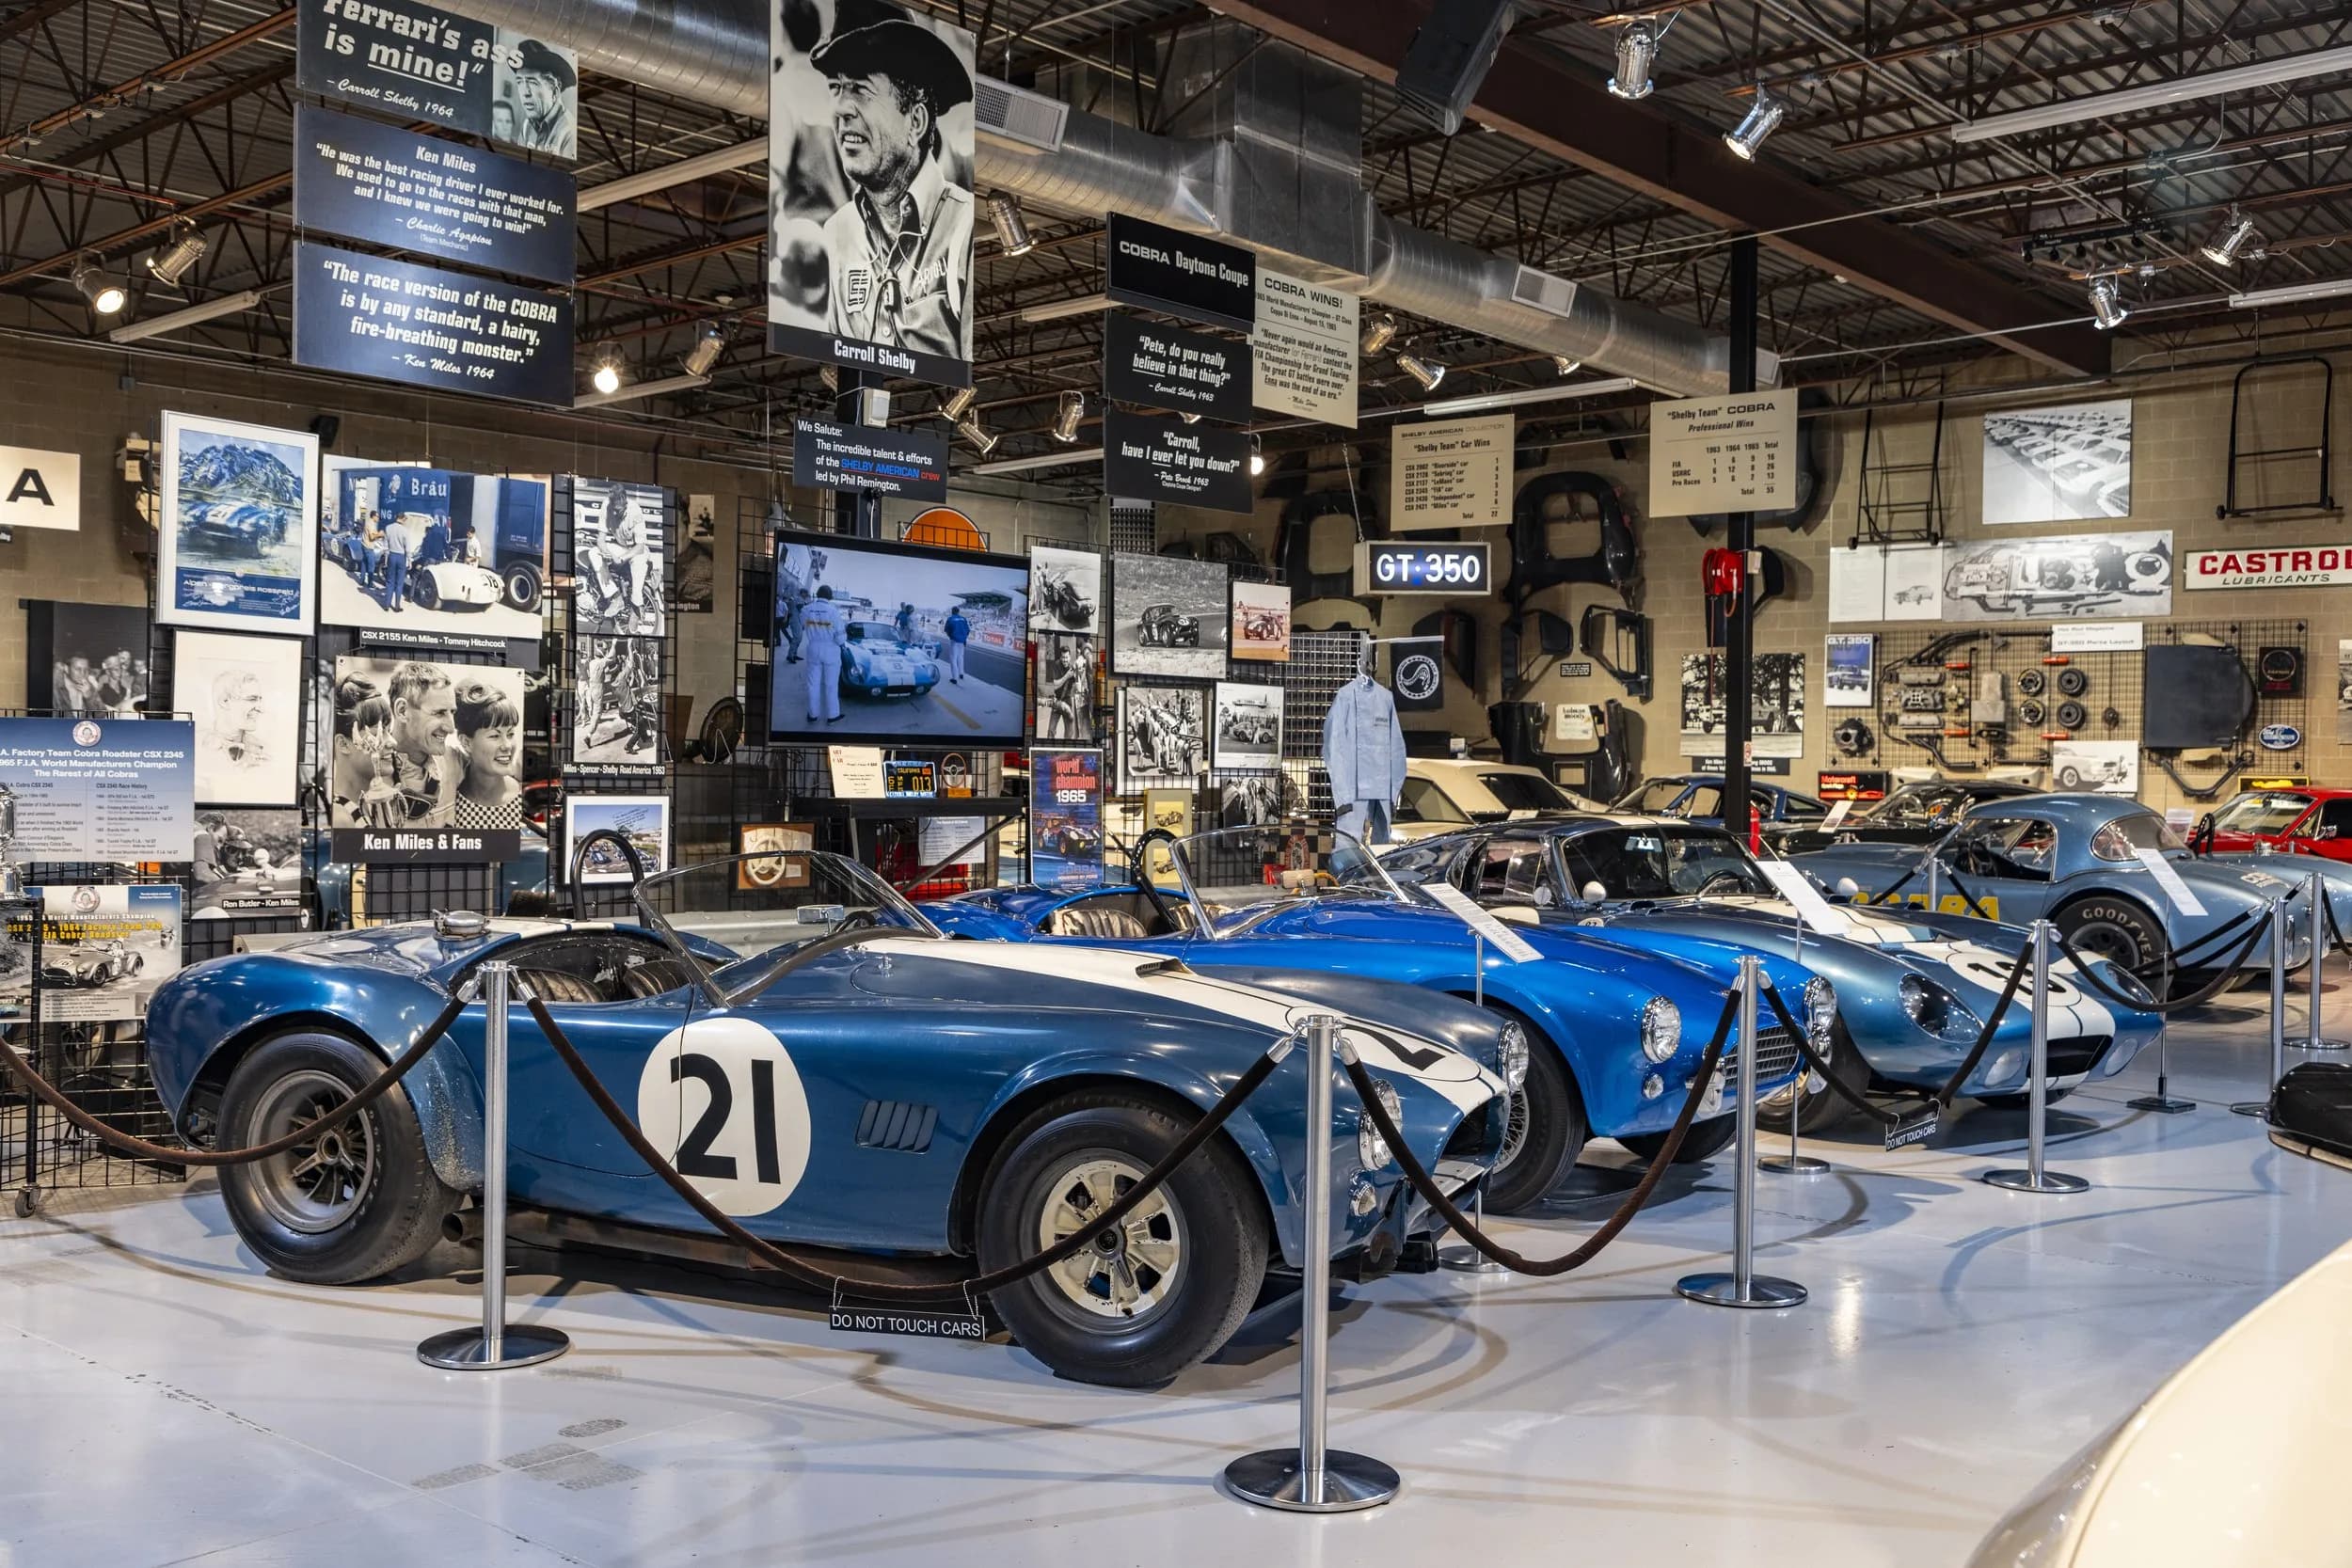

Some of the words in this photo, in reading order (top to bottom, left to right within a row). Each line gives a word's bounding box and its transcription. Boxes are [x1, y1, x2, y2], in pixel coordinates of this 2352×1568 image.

[325, 23, 356, 55] is
[471, 38, 524, 69] ass
[339, 78, 379, 100] Carroll
[384, 91, 420, 111] Shelby
[424, 103, 454, 118] 1964
[416, 146, 438, 163] Ken
[443, 152, 476, 173] Miles
[336, 164, 354, 178] We
[357, 170, 382, 184] used
[386, 174, 396, 188] to
[399, 181, 411, 194] go
[415, 182, 425, 195] to
[429, 186, 445, 200] the
[448, 193, 475, 207] races
[479, 198, 501, 214] with
[503, 203, 522, 218] that
[524, 211, 547, 227] man,
[340, 152, 361, 165] was
[364, 155, 381, 170] the
[385, 160, 407, 176] best
[410, 168, 441, 187] racing
[445, 173, 476, 191] driver
[485, 187, 508, 201] ever
[510, 193, 545, 209] worked
[548, 200, 564, 215] for.
[354, 184, 373, 198] and
[385, 192, 412, 207] knew
[415, 200, 431, 212] we
[434, 204, 460, 218] were
[463, 209, 489, 227] going
[492, 215, 502, 229] to
[1120, 240, 1170, 265] COBRA
[1176, 250, 1216, 277] Daytona
[1219, 262, 1248, 289] Coupe
[364, 274, 400, 293] race
[405, 281, 460, 304] version
[464, 291, 481, 307] of
[484, 294, 506, 314] the
[510, 298, 557, 324] COBRA
[1264, 277, 1306, 298] COBRA
[1310, 291, 1343, 309] WINS!
[341, 290, 356, 309] is
[359, 293, 379, 316] by
[383, 302, 411, 322] any
[414, 307, 484, 336] standard,
[487, 322, 498, 335] a
[501, 320, 541, 347] hairy,
[350, 316, 458, 355] fire-breathing
[404, 353, 425, 369] Ken
[430, 357, 461, 375] Miles
[467, 364, 495, 380] 1964
[834, 339, 875, 363] Carroll
[879, 348, 915, 374] Shelby
[1133, 354, 1165, 373] believe
[1168, 360, 1176, 375] in
[1179, 364, 1197, 380] that
[1169, 342, 1181, 357] do
[1183, 350, 1198, 364] you
[1200, 352, 1226, 368] really
[1727, 403, 1775, 414] COBRA
[798, 420, 813, 432] We
[814, 422, 842, 436] Salute:
[1688, 421, 1734, 433] Professional
[816, 438, 831, 451] The
[834, 441, 871, 457] incredible
[873, 447, 896, 460] talent
[898, 451, 904, 461] &
[906, 452, 932, 466] efforts
[1122, 441, 1143, 458] have
[1152, 451, 1173, 463] ever
[1175, 451, 1187, 466] let
[1189, 457, 1204, 470] you
[816, 455, 825, 466] of
[826, 456, 840, 467] the
[842, 458, 873, 471] SHELBY
[875, 464, 920, 478] AMERICAN
[921, 471, 940, 481] crew
[816, 470, 828, 482] led
[829, 472, 839, 485] by
[840, 474, 856, 486] Phil
[857, 476, 901, 492] Remington.
[6, 467, 55, 506] A
[412, 478, 447, 497] Bräu
[2222, 574, 2330, 585] LUBRICANTS
[361, 630, 377, 641] CSX
[379, 631, 400, 642] 2155
[402, 633, 419, 643] Ken
[419, 634, 438, 644] Miles
[443, 637, 469, 648] Tommy
[470, 637, 506, 649] Hitchcock
[12, 749, 44, 760] Factory
[103, 750, 141, 758] Roadster
[41, 759, 68, 768] World
[70, 760, 132, 768] Manufacturers
[134, 761, 177, 769] Champion
[1057, 758, 1080, 773] world
[53, 769, 81, 778] Rarest
[82, 769, 93, 778] of
[107, 770, 139, 779] Cobras
[1057, 774, 1095, 789] champion
[1056, 790, 1086, 802] 1965
[364, 833, 390, 850] Ken
[395, 833, 434, 851] Miles
[437, 834, 449, 850] &
[452, 834, 483, 851] Fans
[238, 899, 260, 908] Butler
[265, 899, 279, 908] Ken
[670, 1053, 781, 1184] 21
[1887, 1139, 1895, 1149] DO
[1895, 1135, 1906, 1147] NOT
[1907, 1129, 1923, 1143] TOUCH
[1923, 1124, 1936, 1137] CARS
[832, 1314, 851, 1327] DO
[856, 1315, 887, 1330] NOT
[888, 1318, 937, 1334] TOUCH
[941, 1322, 980, 1337] CARS
